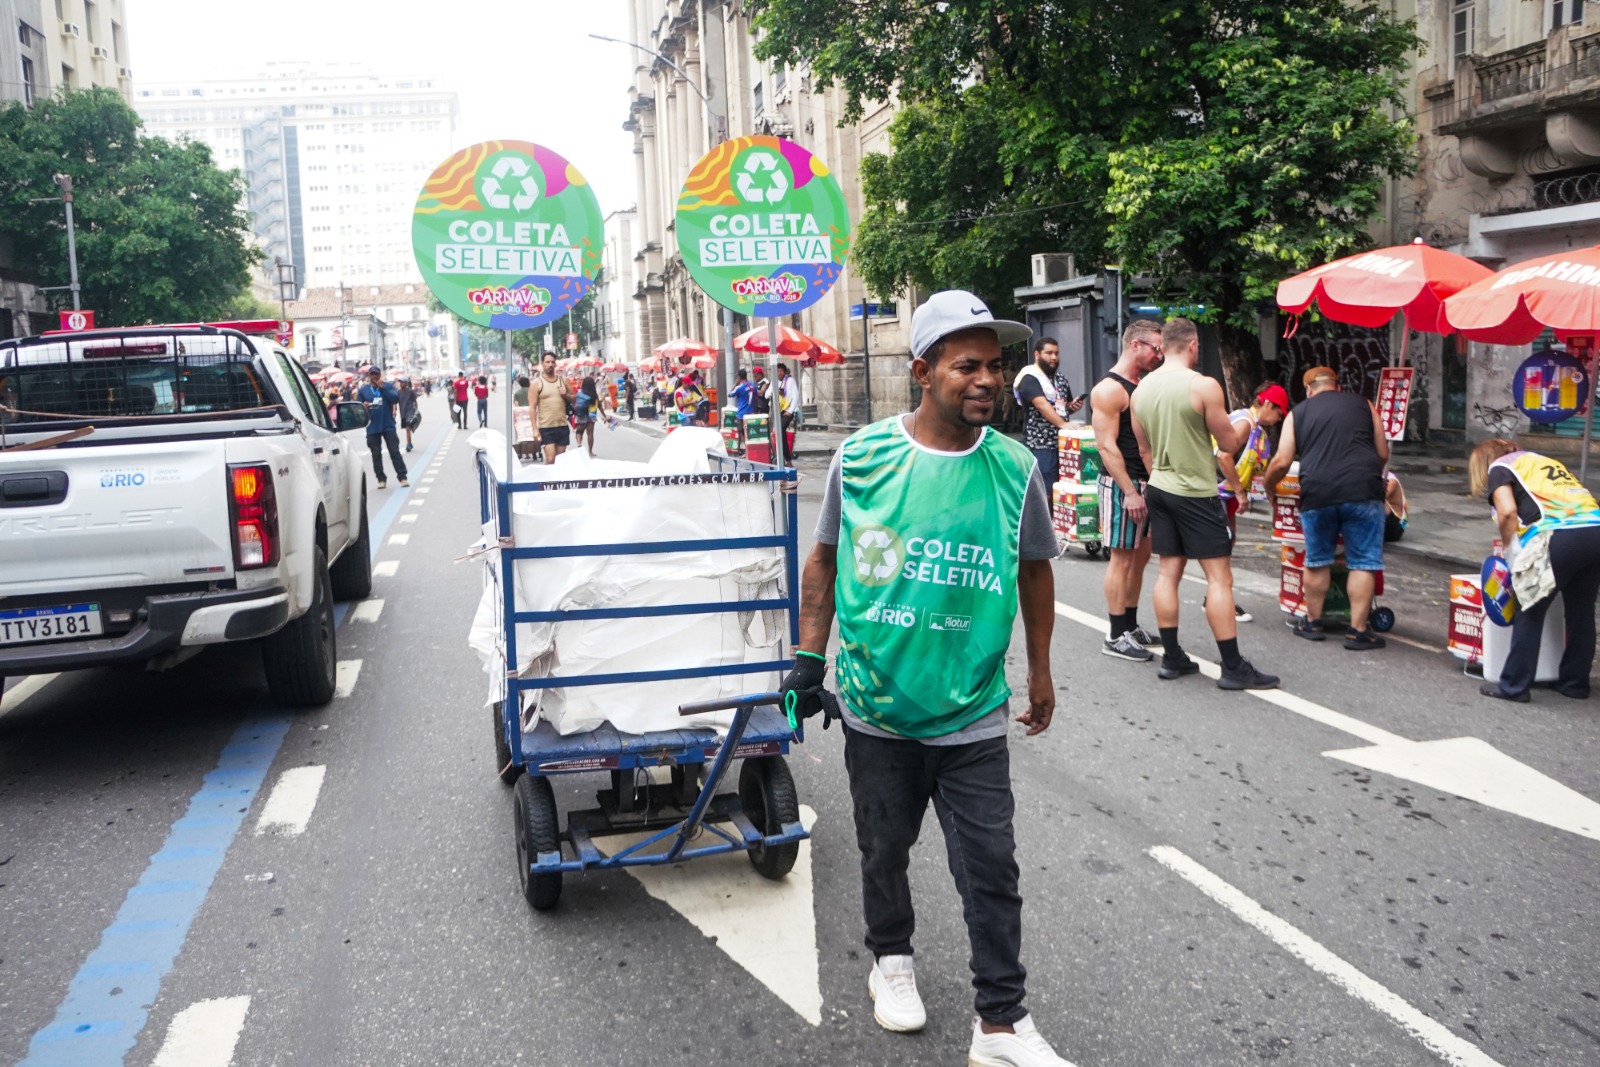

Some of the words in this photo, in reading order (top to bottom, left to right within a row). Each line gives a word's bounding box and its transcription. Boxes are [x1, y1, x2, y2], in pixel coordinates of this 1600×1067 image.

[448, 219, 571, 246] COLETA
[709, 213, 820, 237] COLETA
[441, 247, 577, 272] SELETIVA
[705, 239, 827, 263] SELETIVA
[736, 278, 803, 295] CARNAVAL
[1490, 261, 1600, 290] BRAHM
[472, 289, 547, 306] CARNAVAL
[115, 472, 145, 487] RIO
[905, 537, 995, 568] COLETA
[902, 560, 1003, 596] SELETIVA
[869, 600, 916, 611] PREFEITURA
[0, 614, 91, 640] TTY3I81
[881, 608, 916, 628] RIO
[944, 616, 970, 629] Riotur
